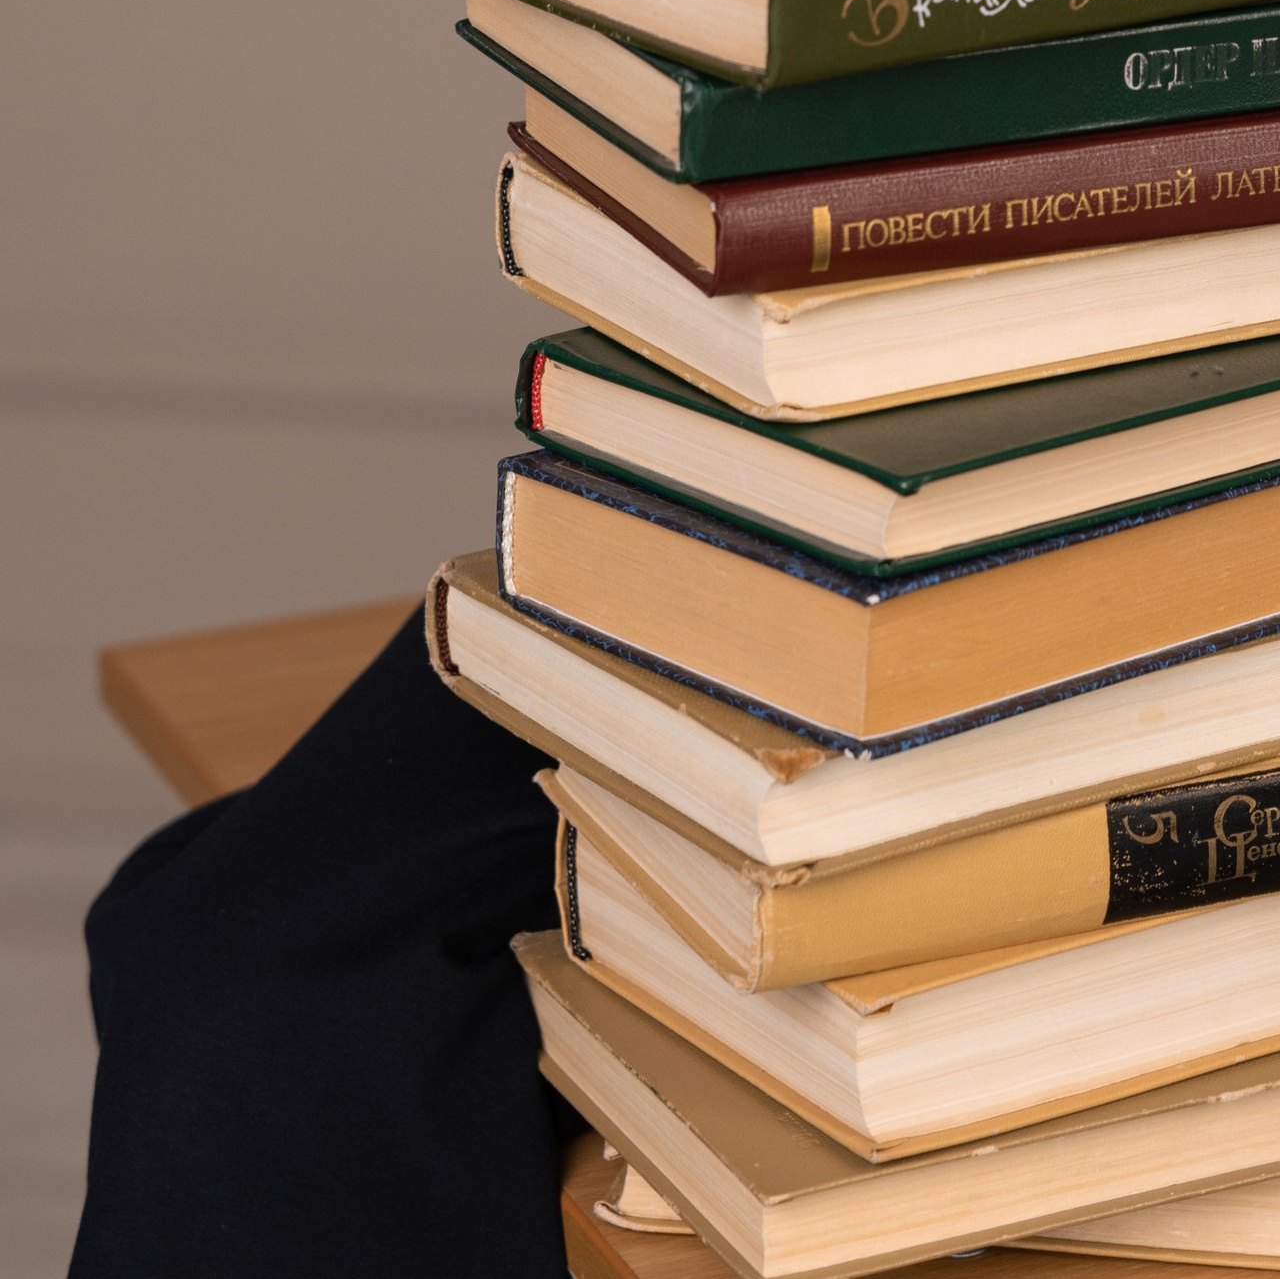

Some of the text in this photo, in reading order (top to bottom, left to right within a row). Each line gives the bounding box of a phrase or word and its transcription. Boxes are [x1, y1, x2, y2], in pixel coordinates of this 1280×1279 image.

[1124, 42, 1240, 91] ОРДЕР
[841, 203, 991, 252] ПОВЕСТИ
[1005, 168, 1197, 229] ПИСАТЕЛЕЙ
[1122, 810, 1179, 844] 5
